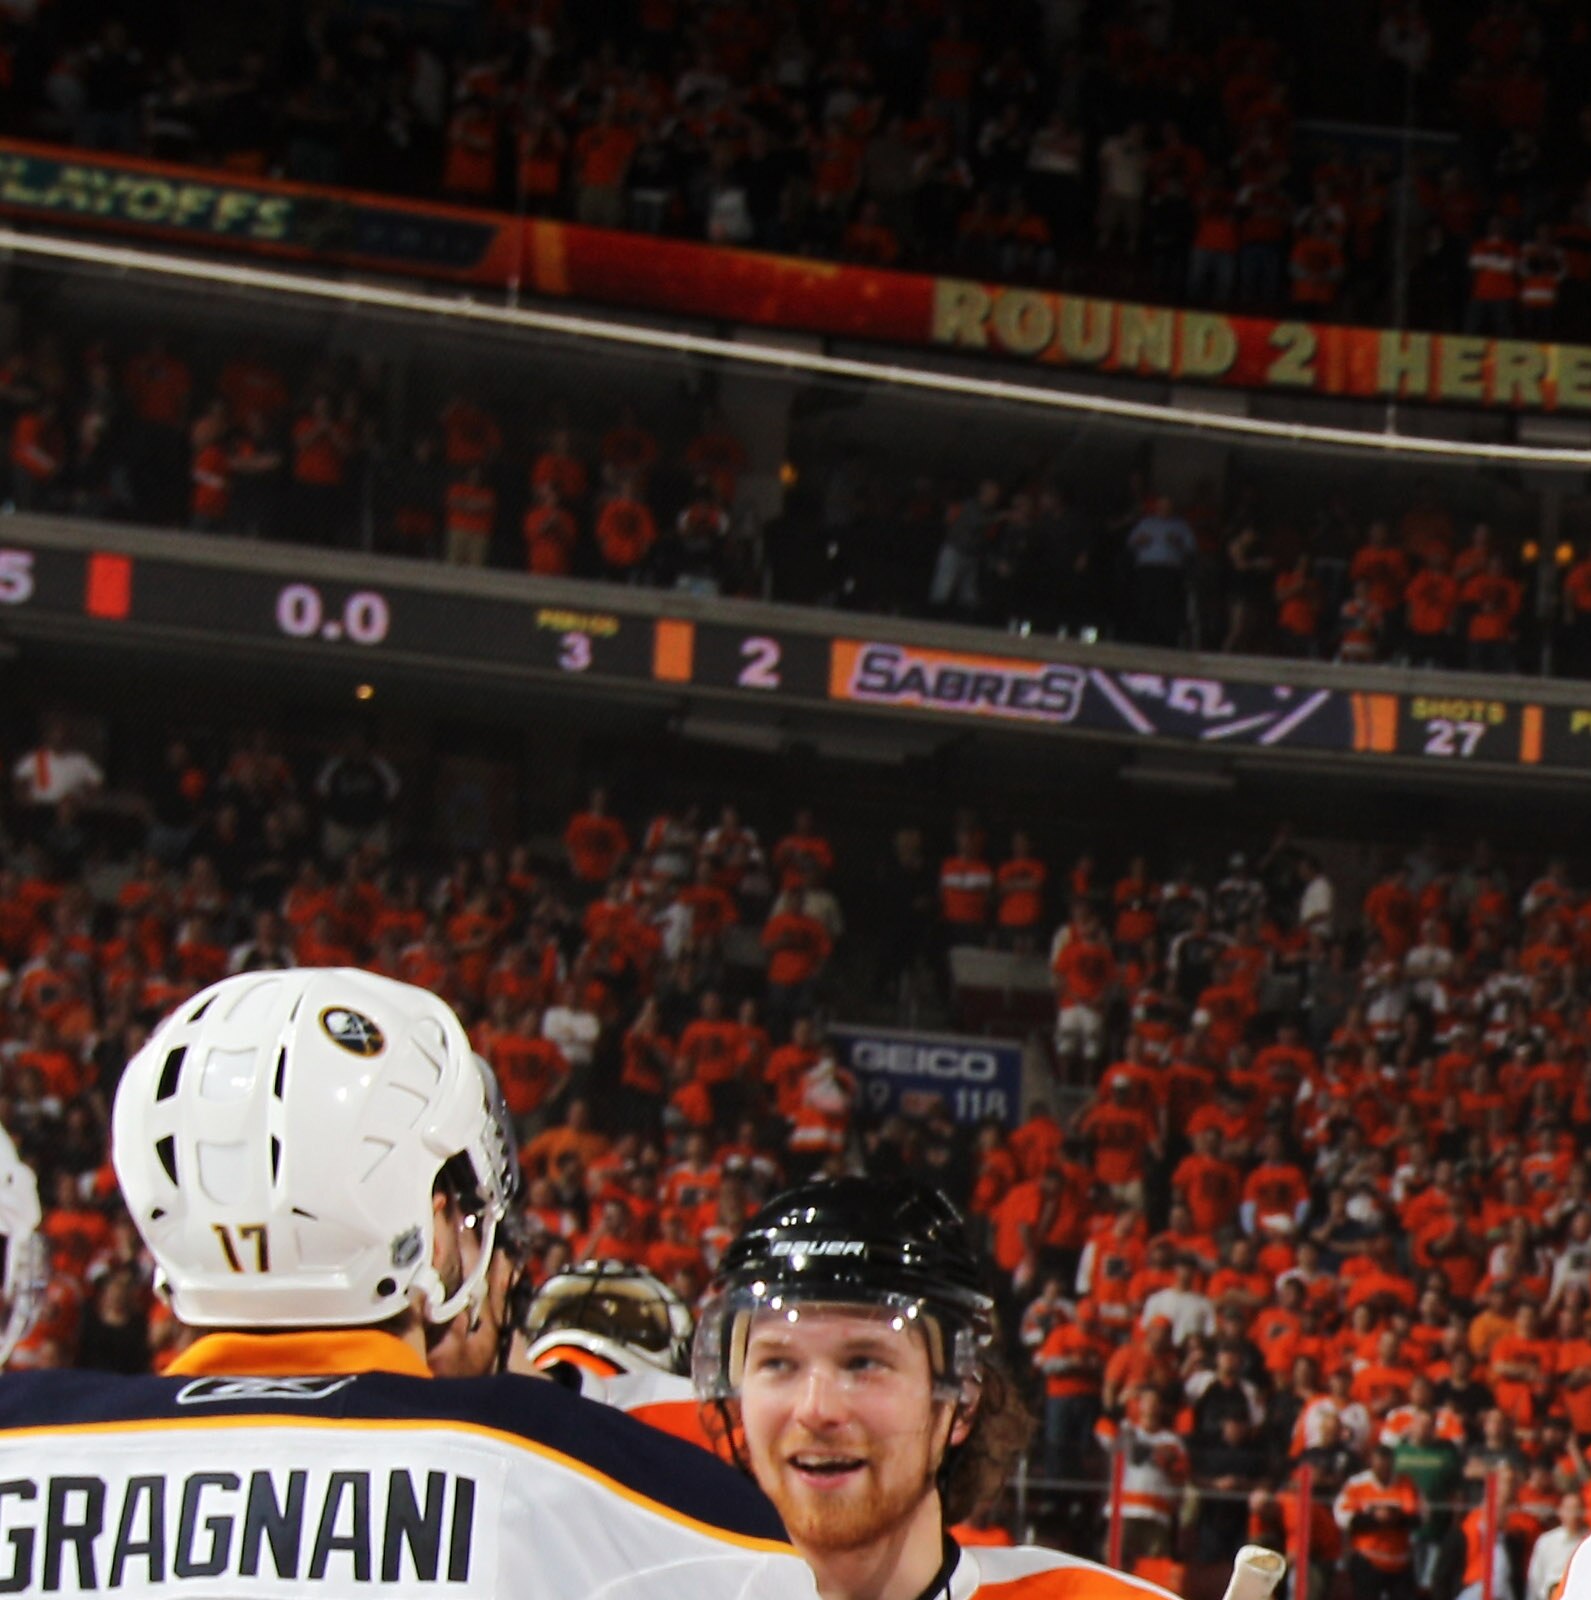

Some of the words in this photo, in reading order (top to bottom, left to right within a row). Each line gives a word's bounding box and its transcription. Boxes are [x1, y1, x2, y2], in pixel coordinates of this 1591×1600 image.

[932, 276, 1236, 380] ROUND
[1264, 320, 1318, 387] 2
[277, 584, 389, 645] 0.0
[557, 630, 592, 672] 3
[740, 638, 781, 689] 2
[857, 645, 1079, 716] SABRES
[1411, 697, 1505, 726] SHOTS
[1423, 721, 1485, 757] 27
[852, 1041, 998, 1083] GEICO
[211, 1222, 272, 1274] 17
[0, 1468, 477, 1591] GRAGNANI
